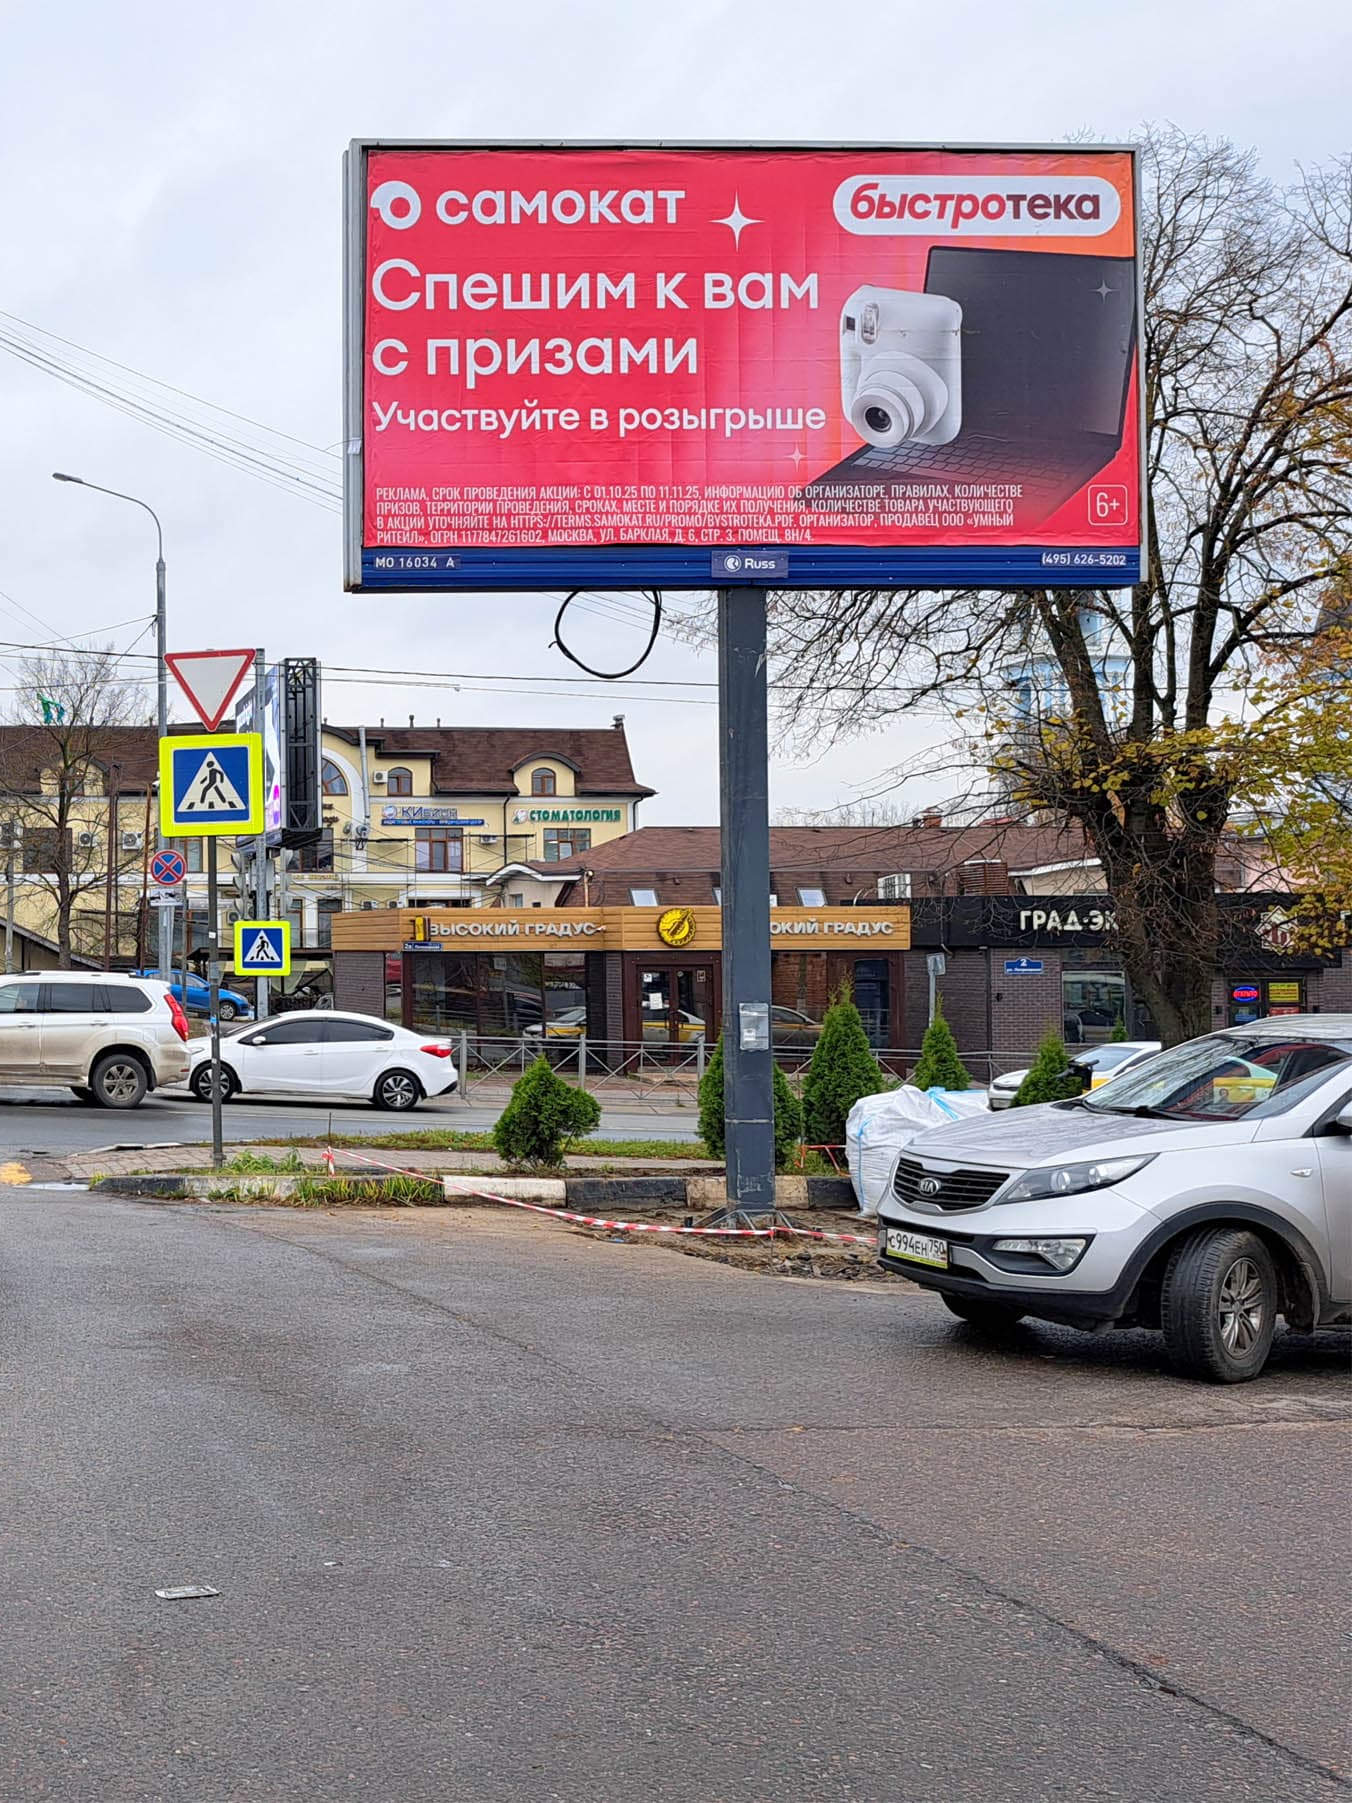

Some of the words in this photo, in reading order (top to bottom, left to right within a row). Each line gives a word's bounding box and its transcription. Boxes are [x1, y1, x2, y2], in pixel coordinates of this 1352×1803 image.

[436, 189, 686, 225] самокат
[850, 182, 1101, 229] быстротека
[371, 258, 635, 311] Спешим
[656, 272, 689, 310] к
[704, 272, 819, 310] вам
[372, 338, 409, 375] с
[426, 337, 698, 389] призами
[372, 399, 581, 439] Участвуйте
[590, 408, 609, 430] в
[618, 406, 827, 437] розыгрыше
[432, 487, 461, 500] СРОК
[463, 486, 537, 502] ПРОВЕДЕНИЯ
[539, 486, 581, 501] АКЦИИ:
[583, 486, 591, 500] С
[594, 486, 638, 499] 01.10.25
[641, 486, 656, 499] ПО
[704, 485, 785, 500] ИНФОРМАЦИЮ
[788, 485, 802, 499] ОБ
[954, 484, 1023, 498] КОЛИЧЕСТВЕ
[425, 501, 494, 514] ТЕРРИТОРИИ
[496, 501, 573, 516] ПРОВЕДЕНИЯ,
[622, 500, 657, 514] МЕСТЕ
[658, 500, 667, 513] И
[669, 500, 721, 515] ПОРЯДКЕ
[722, 500, 738, 513] ИХ
[811, 499, 881, 513] КОЛИЧЕСТВЕ
[884, 499, 925, 513] ТОВАРА
[927, 499, 1014, 514] УЧАСТВУЮЩЕГО
[1096, 492, 1120, 517] 6+
[376, 516, 384, 529] В
[387, 516, 425, 530] АКЦИИ
[427, 516, 490, 530] УТОЧНЯЙТЕ
[492, 516, 508, 529] НА
[879, 513, 940, 529] ПРОДАВЕЦ
[941, 513, 965, 527] ООО
[966, 513, 1014, 528] «УМНЫЙ
[430, 531, 459, 543] ОГРН
[548, 530, 597, 544] МОСКВА,
[599, 530, 618, 544] УЛ.
[700, 529, 724, 542] СТР.
[375, 558, 394, 568] МО
[399, 557, 438, 568] 16034
[744, 558, 776, 569] Russ
[1042, 552, 1071, 565] (495)
[1073, 554, 1127, 566] 626-5202
[530, 810, 621, 821] СТОМАТОЛОГИЯ
[525, 922, 596, 936] ГРАДУС
[771, 918, 818, 934] ОКИЙ
[824, 921, 893, 936] ГРАДУС
